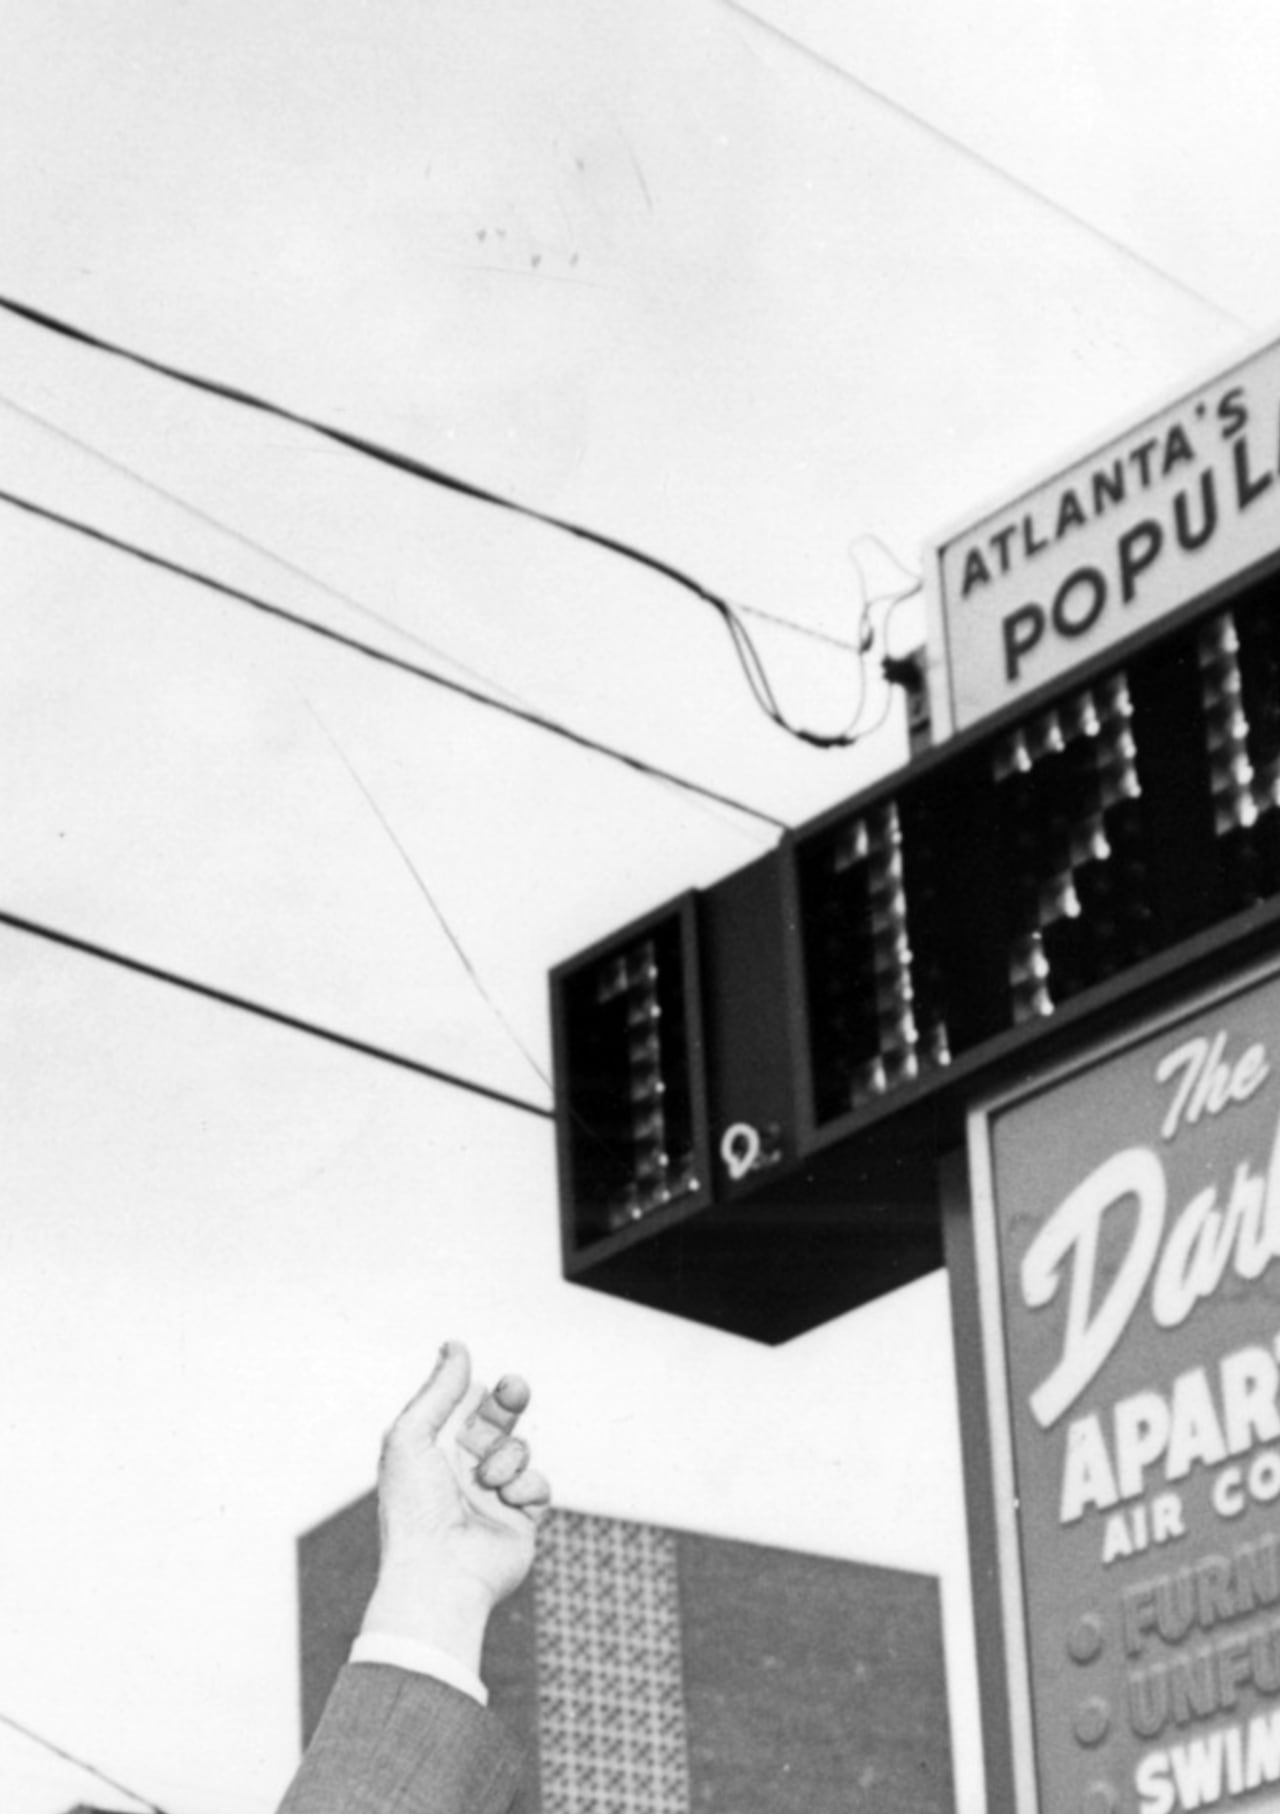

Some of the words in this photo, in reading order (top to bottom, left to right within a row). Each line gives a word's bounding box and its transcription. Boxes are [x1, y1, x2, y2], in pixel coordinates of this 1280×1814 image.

[960, 386, 1249, 599] ATLANTA'S
[1156, 1030, 1269, 1139] The
[1102, 1493, 1186, 1562] AIR
